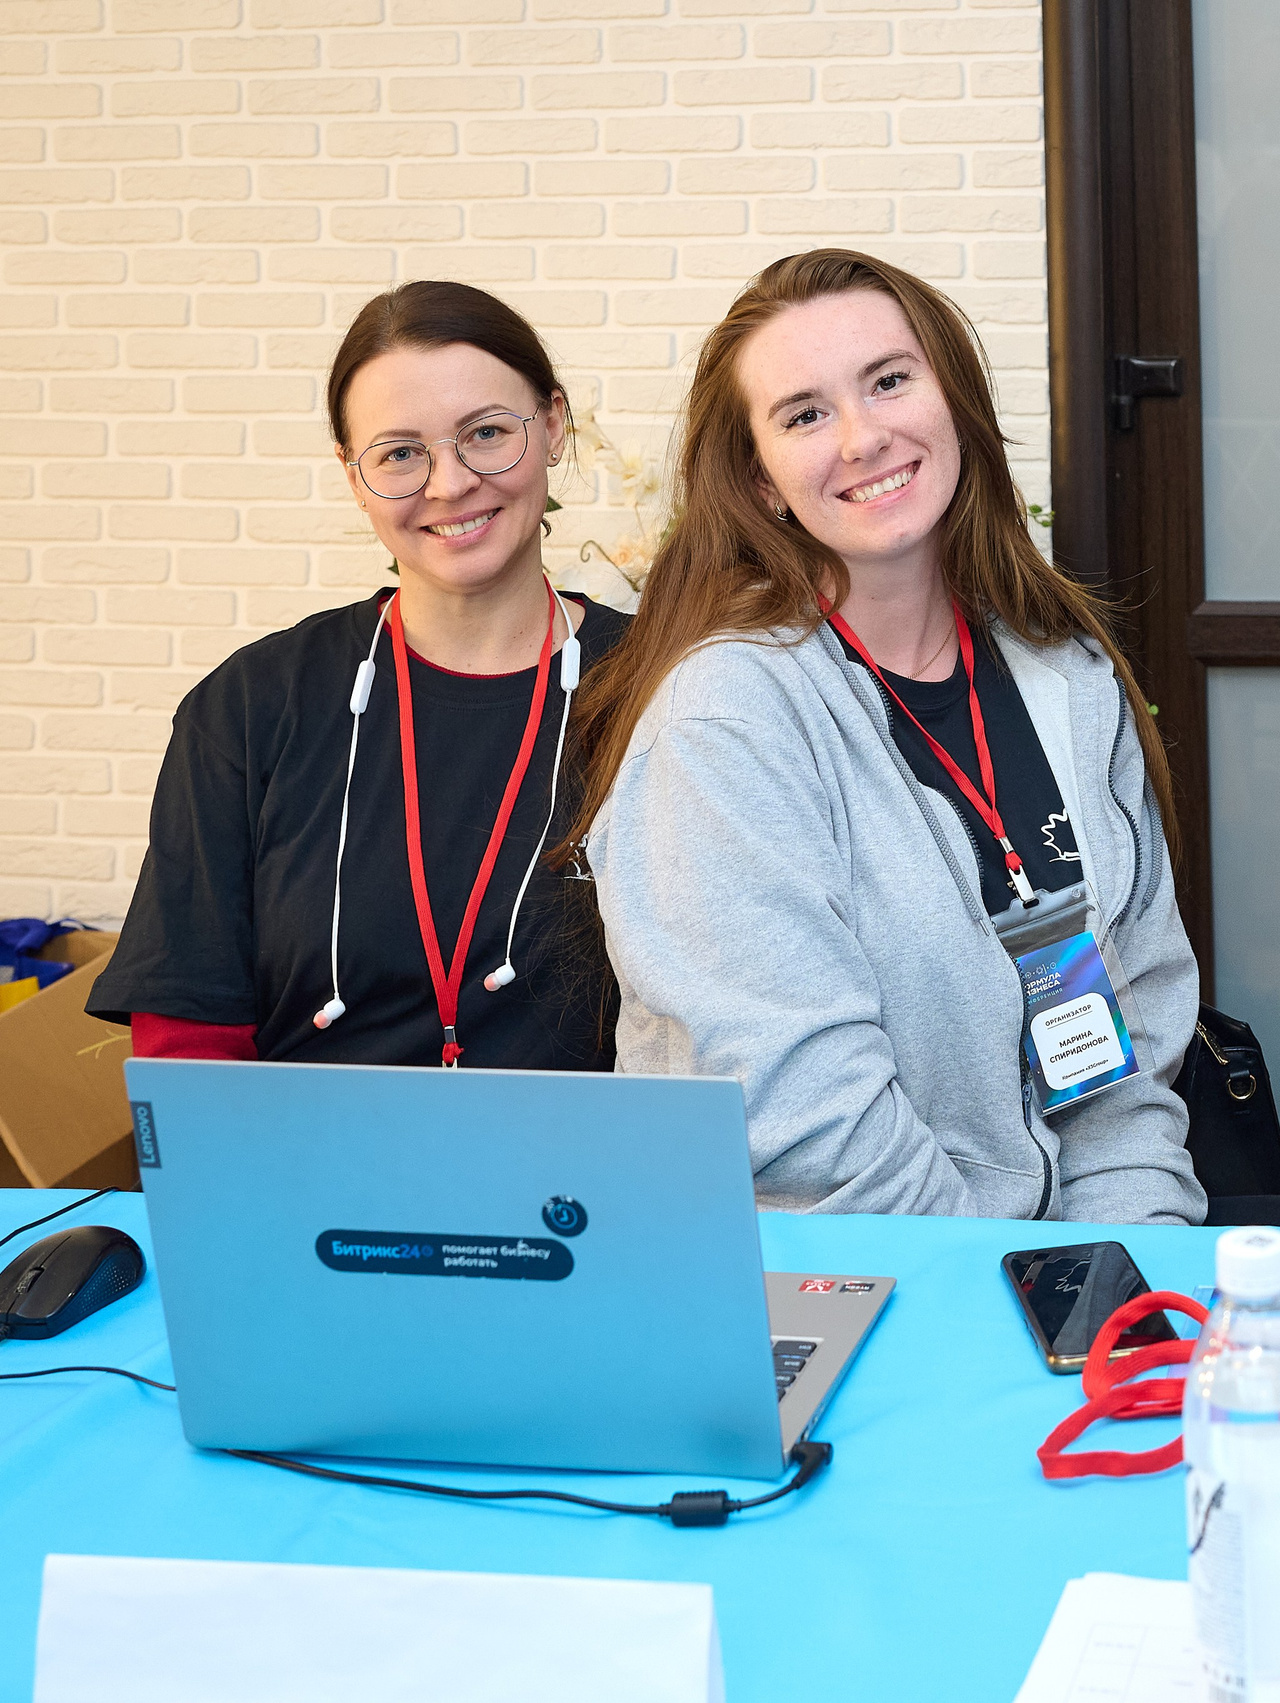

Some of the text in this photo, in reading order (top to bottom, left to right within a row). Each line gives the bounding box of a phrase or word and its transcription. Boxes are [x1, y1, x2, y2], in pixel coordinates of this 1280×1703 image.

[1024, 971, 1062, 990] ОРМУЛА
[1026, 979, 1061, 996] ЗНЕСА
[1045, 1004, 1092, 1027] ОРГАНИЗАТОР
[1059, 1030, 1093, 1048] МАРИНА
[1049, 1035, 1109, 1064] СПИРИДОНОВА
[137, 1106, 156, 1163] Lenovo
[442, 1244, 498, 1257] помогает
[500, 1244, 550, 1260] бизнесу
[443, 1256, 498, 1268] работать
